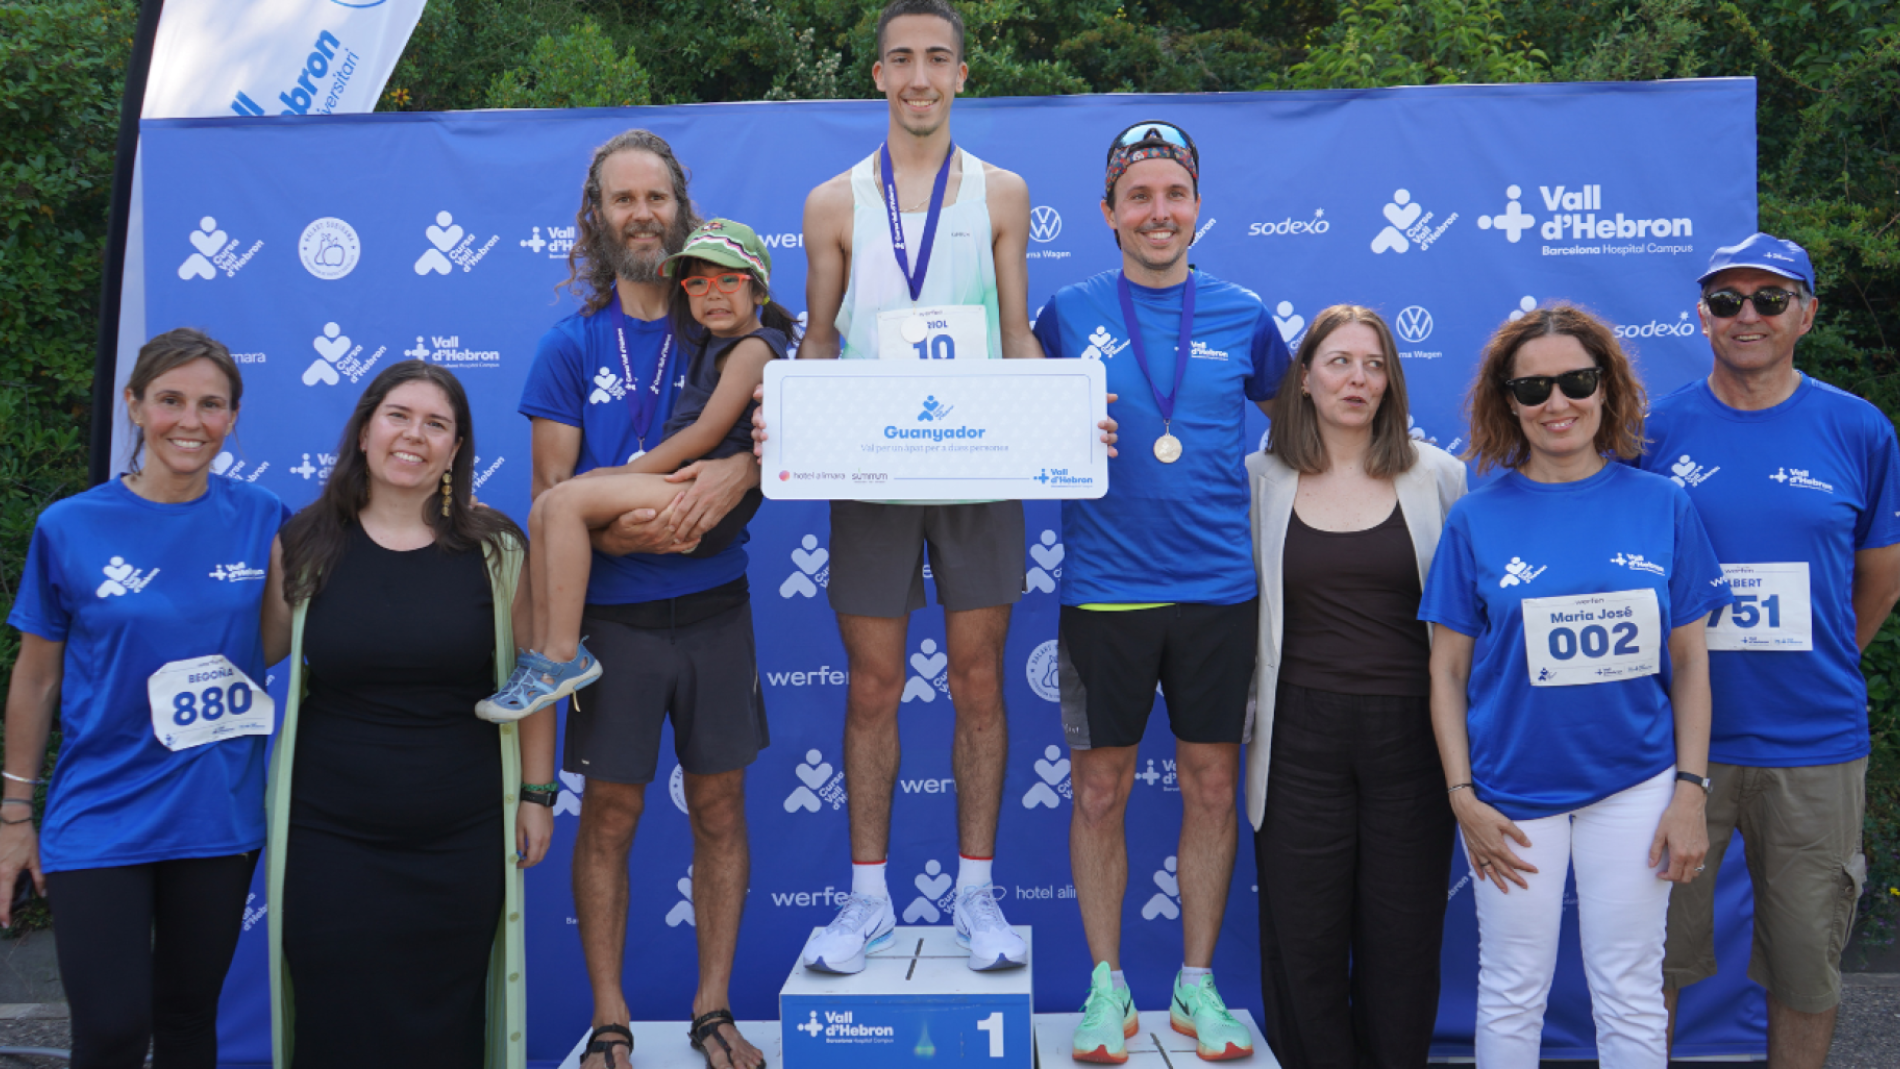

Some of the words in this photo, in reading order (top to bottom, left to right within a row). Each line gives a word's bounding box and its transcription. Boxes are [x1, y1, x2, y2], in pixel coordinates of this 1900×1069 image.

[279, 29, 341, 116] bron
[319, 48, 360, 115] versitari
[230, 90, 265, 116] ll
[1539, 184, 1601, 211] Vall
[547, 226, 575, 239] Vall
[1248, 215, 1330, 236] sodexo
[1541, 213, 1693, 240] d'Hebron
[1042, 249, 1071, 260] Wagen
[1542, 245, 1600, 256] Barcelona
[1602, 244, 1645, 256] Hospital
[1646, 243, 1693, 255] Campus
[926, 320, 948, 329] RIOL
[1614, 320, 1695, 338] sodexo
[431, 336, 459, 348] Vall
[229, 352, 266, 364] mara
[431, 349, 499, 361] d'Hebron
[1414, 350, 1443, 360] Wagen
[884, 425, 986, 442] Guanyador
[860, 444, 874, 452] Val
[876, 445, 889, 453] per
[925, 445, 939, 453] per
[471, 456, 505, 493] Hebron
[793, 471, 815, 480] hotel
[1729, 578, 1762, 588] LBERT
[1550, 610, 1594, 624] Maria
[1597, 606, 1633, 620] José
[1548, 621, 1640, 661] 002
[188, 667, 234, 684] BEGOÑA
[766, 665, 850, 686] werfe
[172, 681, 253, 726] 880
[900, 778, 956, 794] wer
[771, 886, 849, 907] werfe
[1016, 885, 1053, 899] hotel
[825, 1010, 853, 1024] Vall
[825, 1024, 894, 1037] d'Hebron
[977, 1012, 1004, 1057] 1
